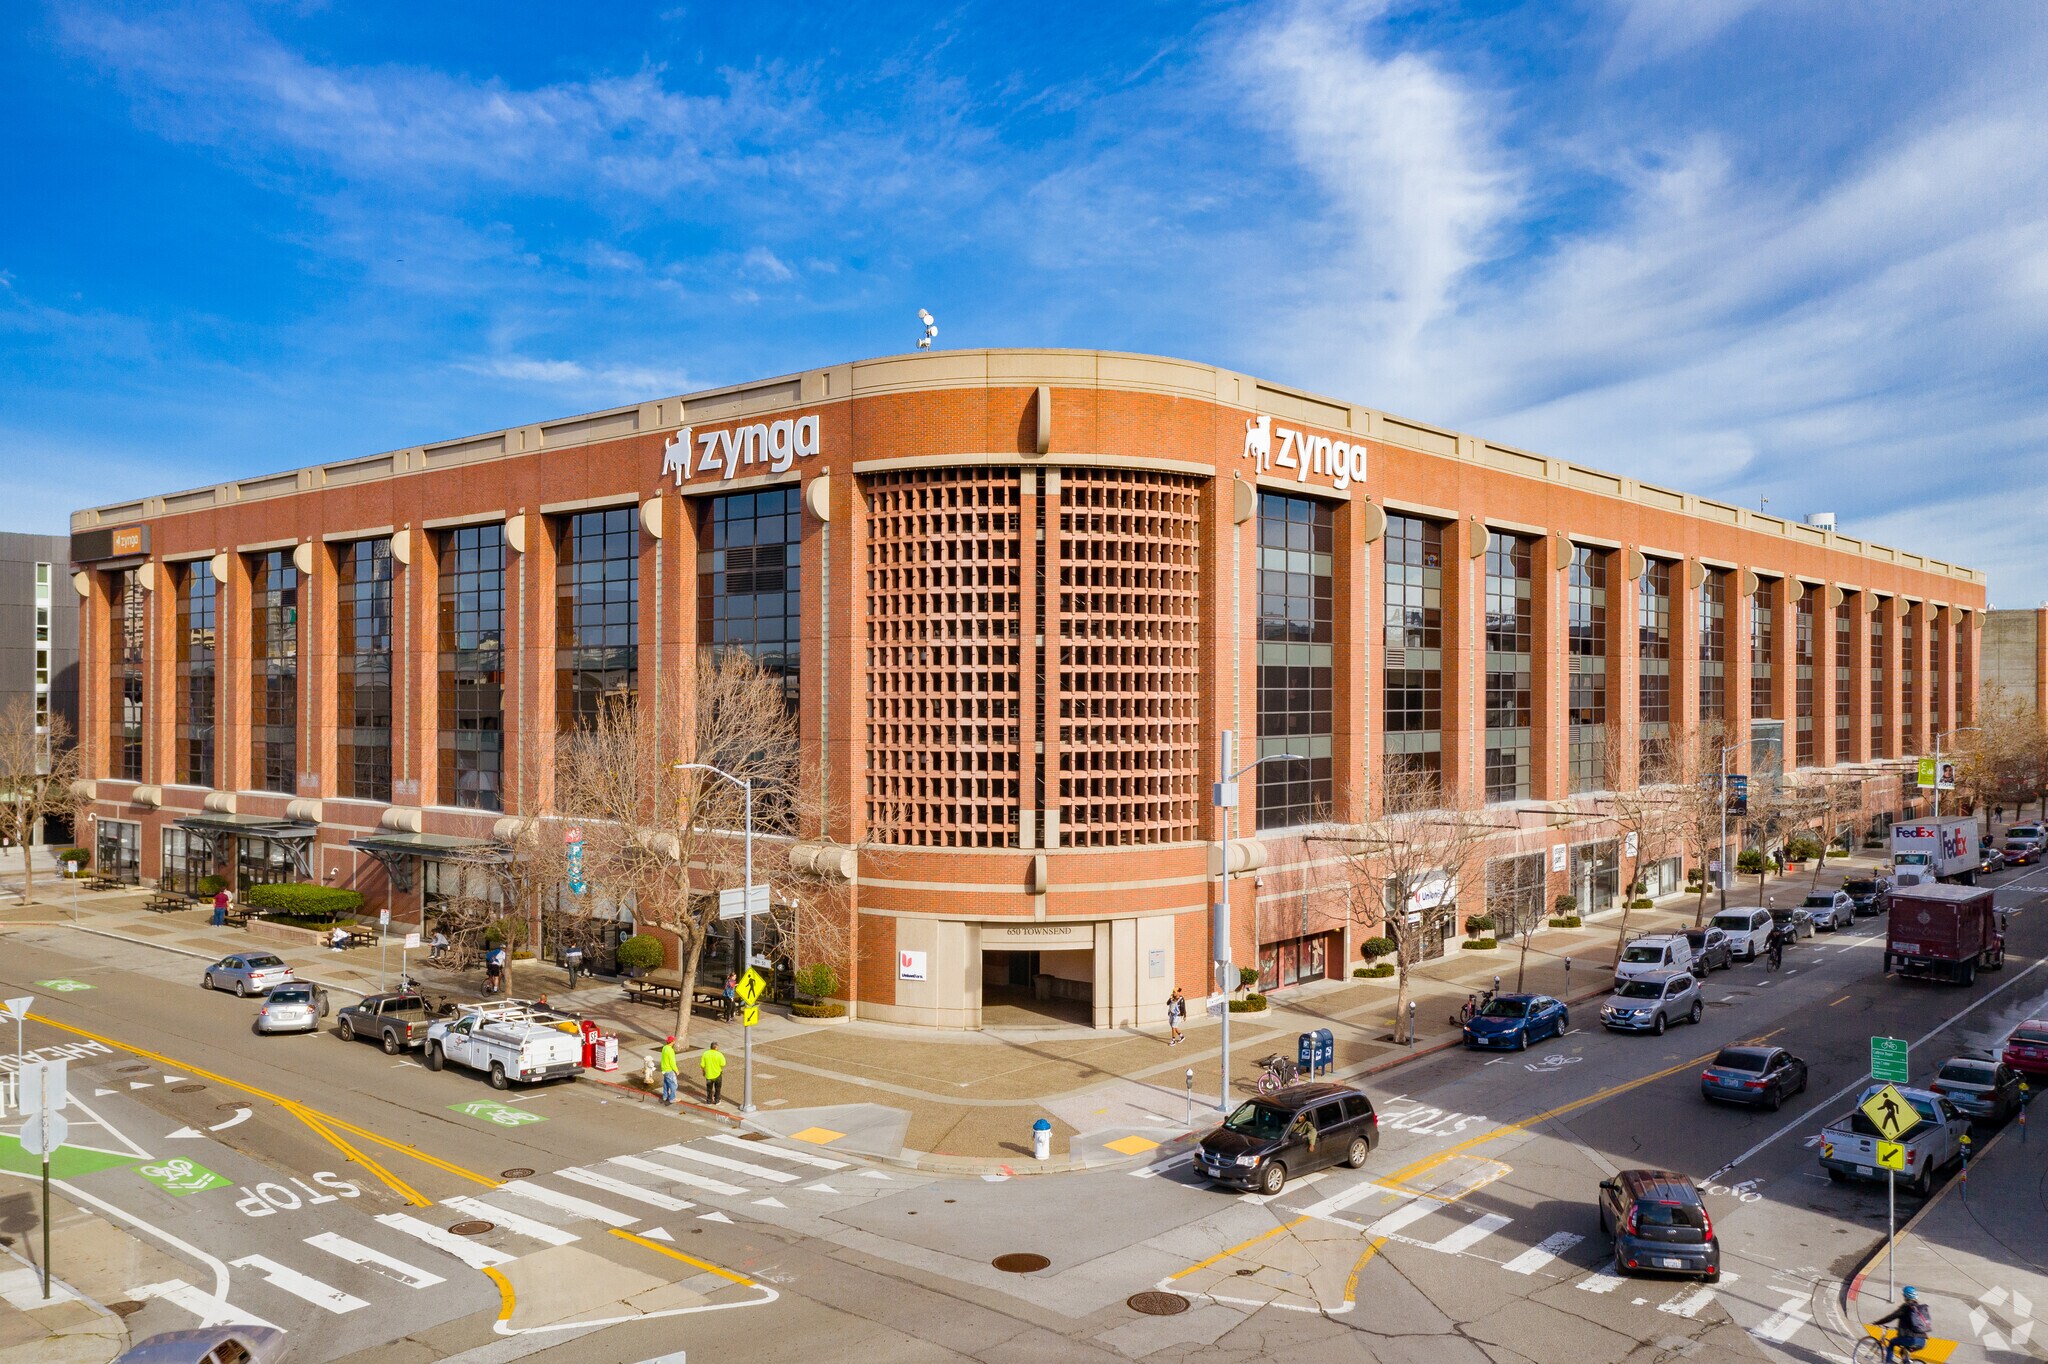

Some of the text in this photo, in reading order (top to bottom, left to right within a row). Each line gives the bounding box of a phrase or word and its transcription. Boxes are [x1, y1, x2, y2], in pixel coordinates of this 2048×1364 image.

[697, 415, 820, 480] zynga
[1275, 427, 1367, 490] zynga
[121, 535, 139, 548] zynga
[1896, 826, 1935, 838] FedEx
[1942, 827, 1968, 860] FedEx
[1006, 927, 1072, 936] 650 TOWNSEND
[1377, 1106, 1487, 1137] STOP
[235, 1171, 361, 1217] STOP
